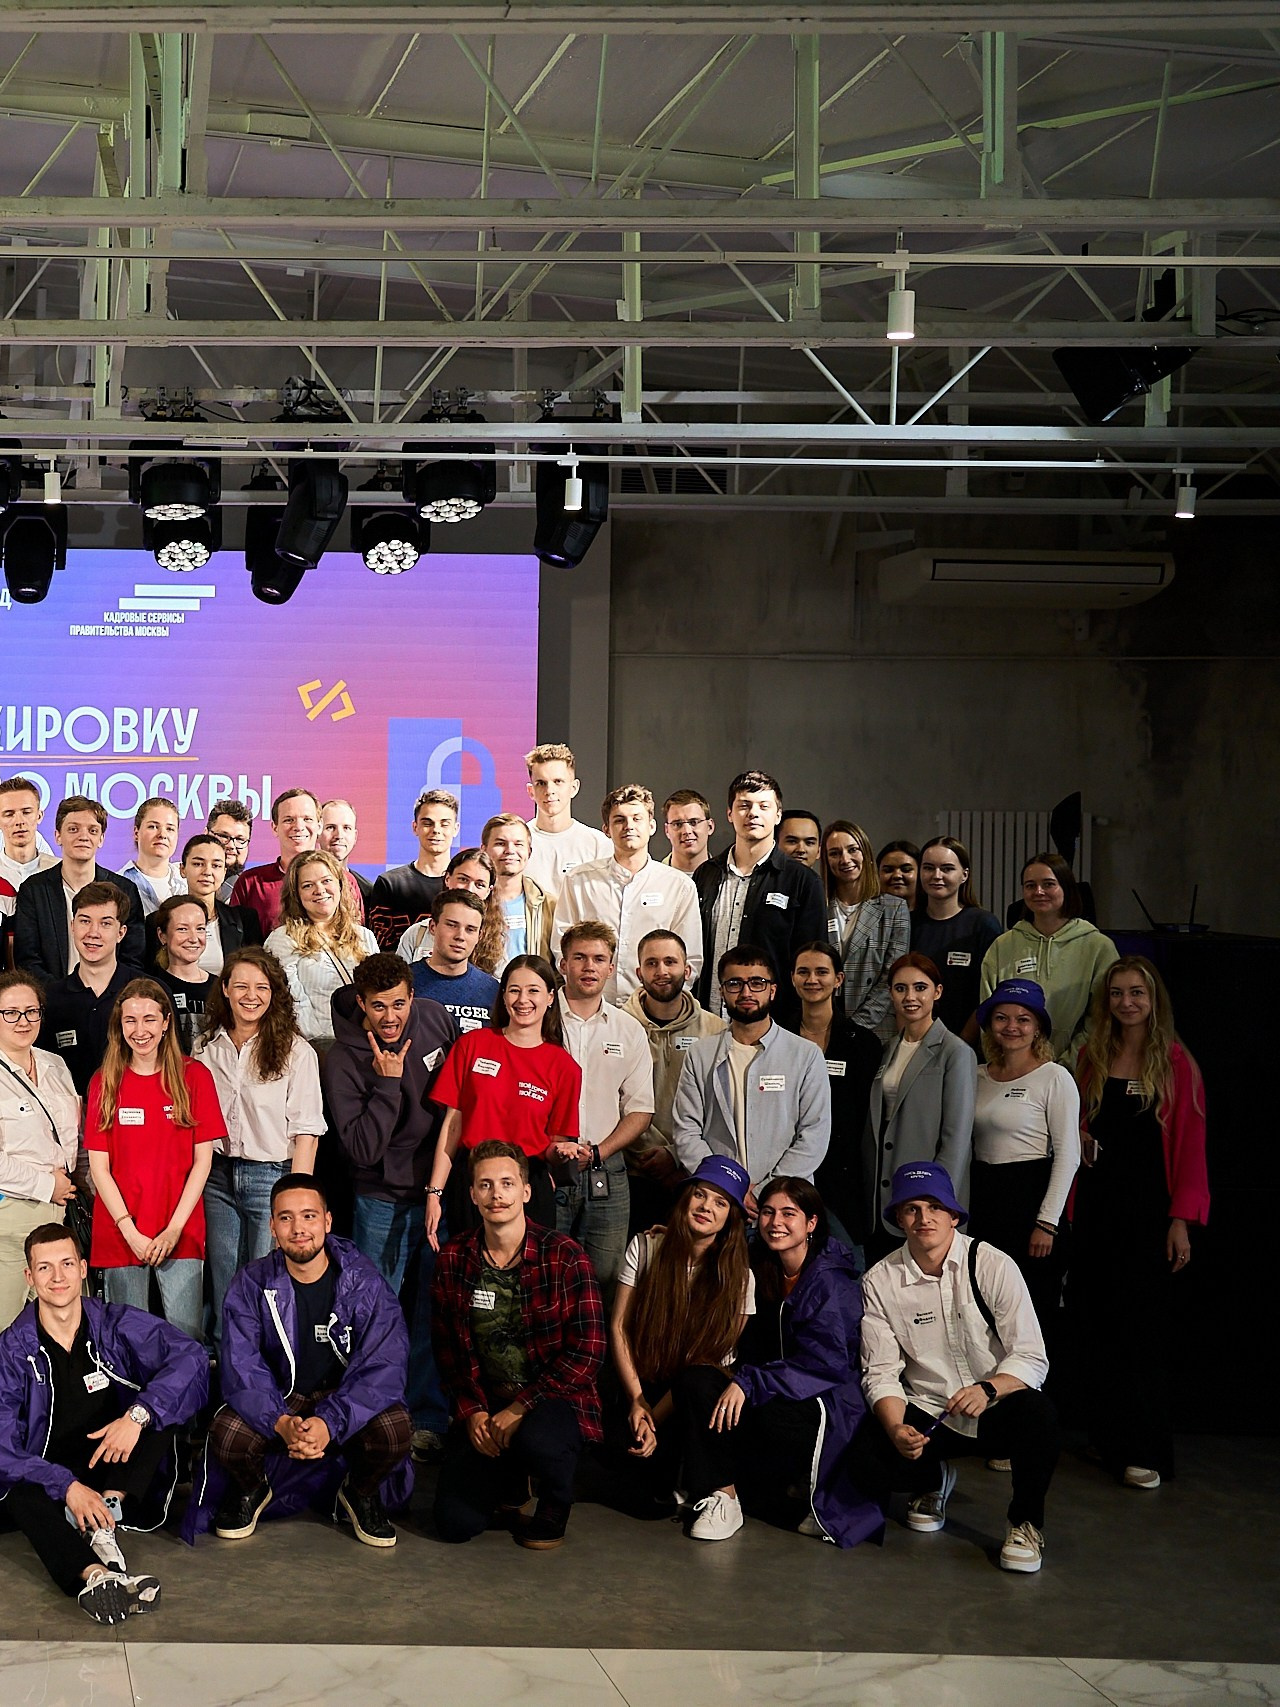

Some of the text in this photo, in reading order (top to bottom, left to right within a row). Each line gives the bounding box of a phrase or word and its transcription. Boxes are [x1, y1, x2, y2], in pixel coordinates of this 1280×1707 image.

[103, 612, 185, 624] КАДРОВЫЕ СЕРВИСЫ
[70, 625, 170, 637] ПРАВИТЕЛЬСТВА МОСКВЫ
